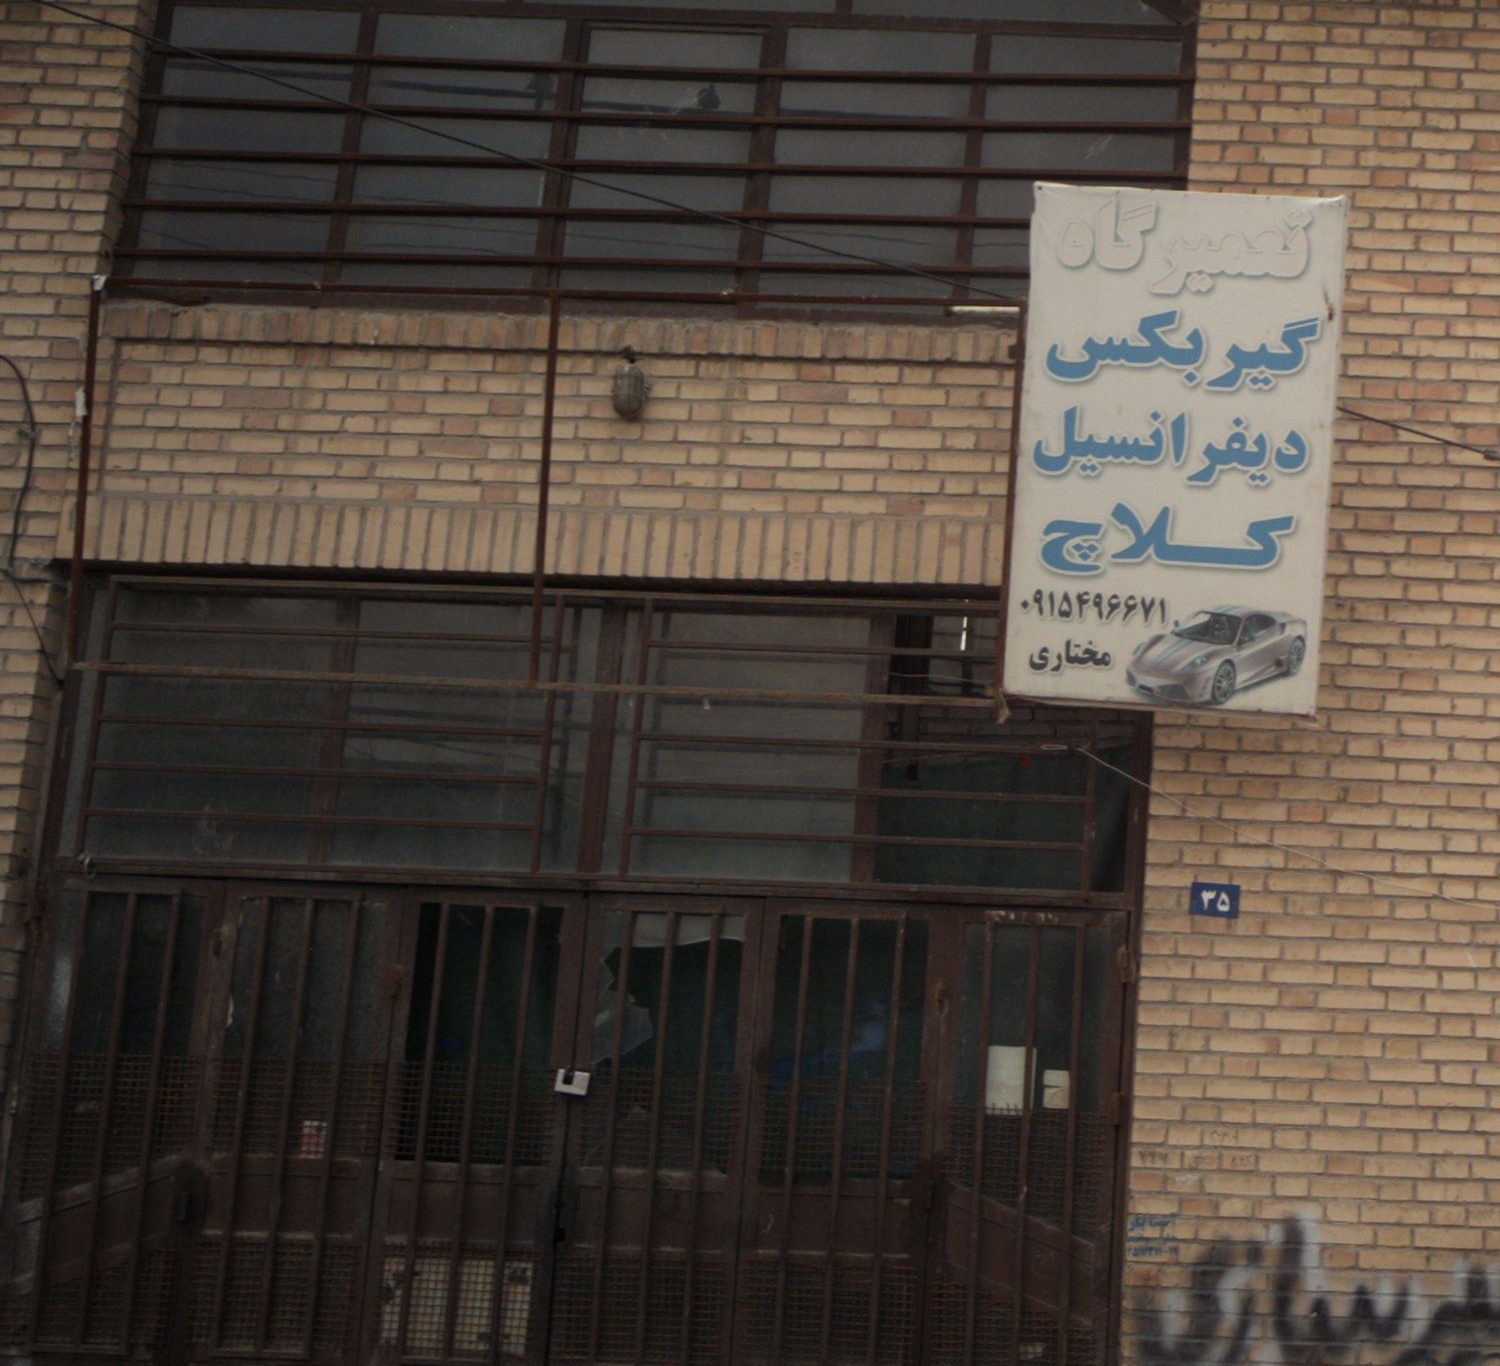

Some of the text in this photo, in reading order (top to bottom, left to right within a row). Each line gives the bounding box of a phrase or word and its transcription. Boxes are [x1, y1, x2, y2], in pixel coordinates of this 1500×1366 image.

[1032, 404, 1308, 486] دیفرانسیل
[1040, 502, 1295, 574] کلاچ
[1028, 638, 1113, 673] مختاری
[1200, 888, 1231, 913] ۳۵
